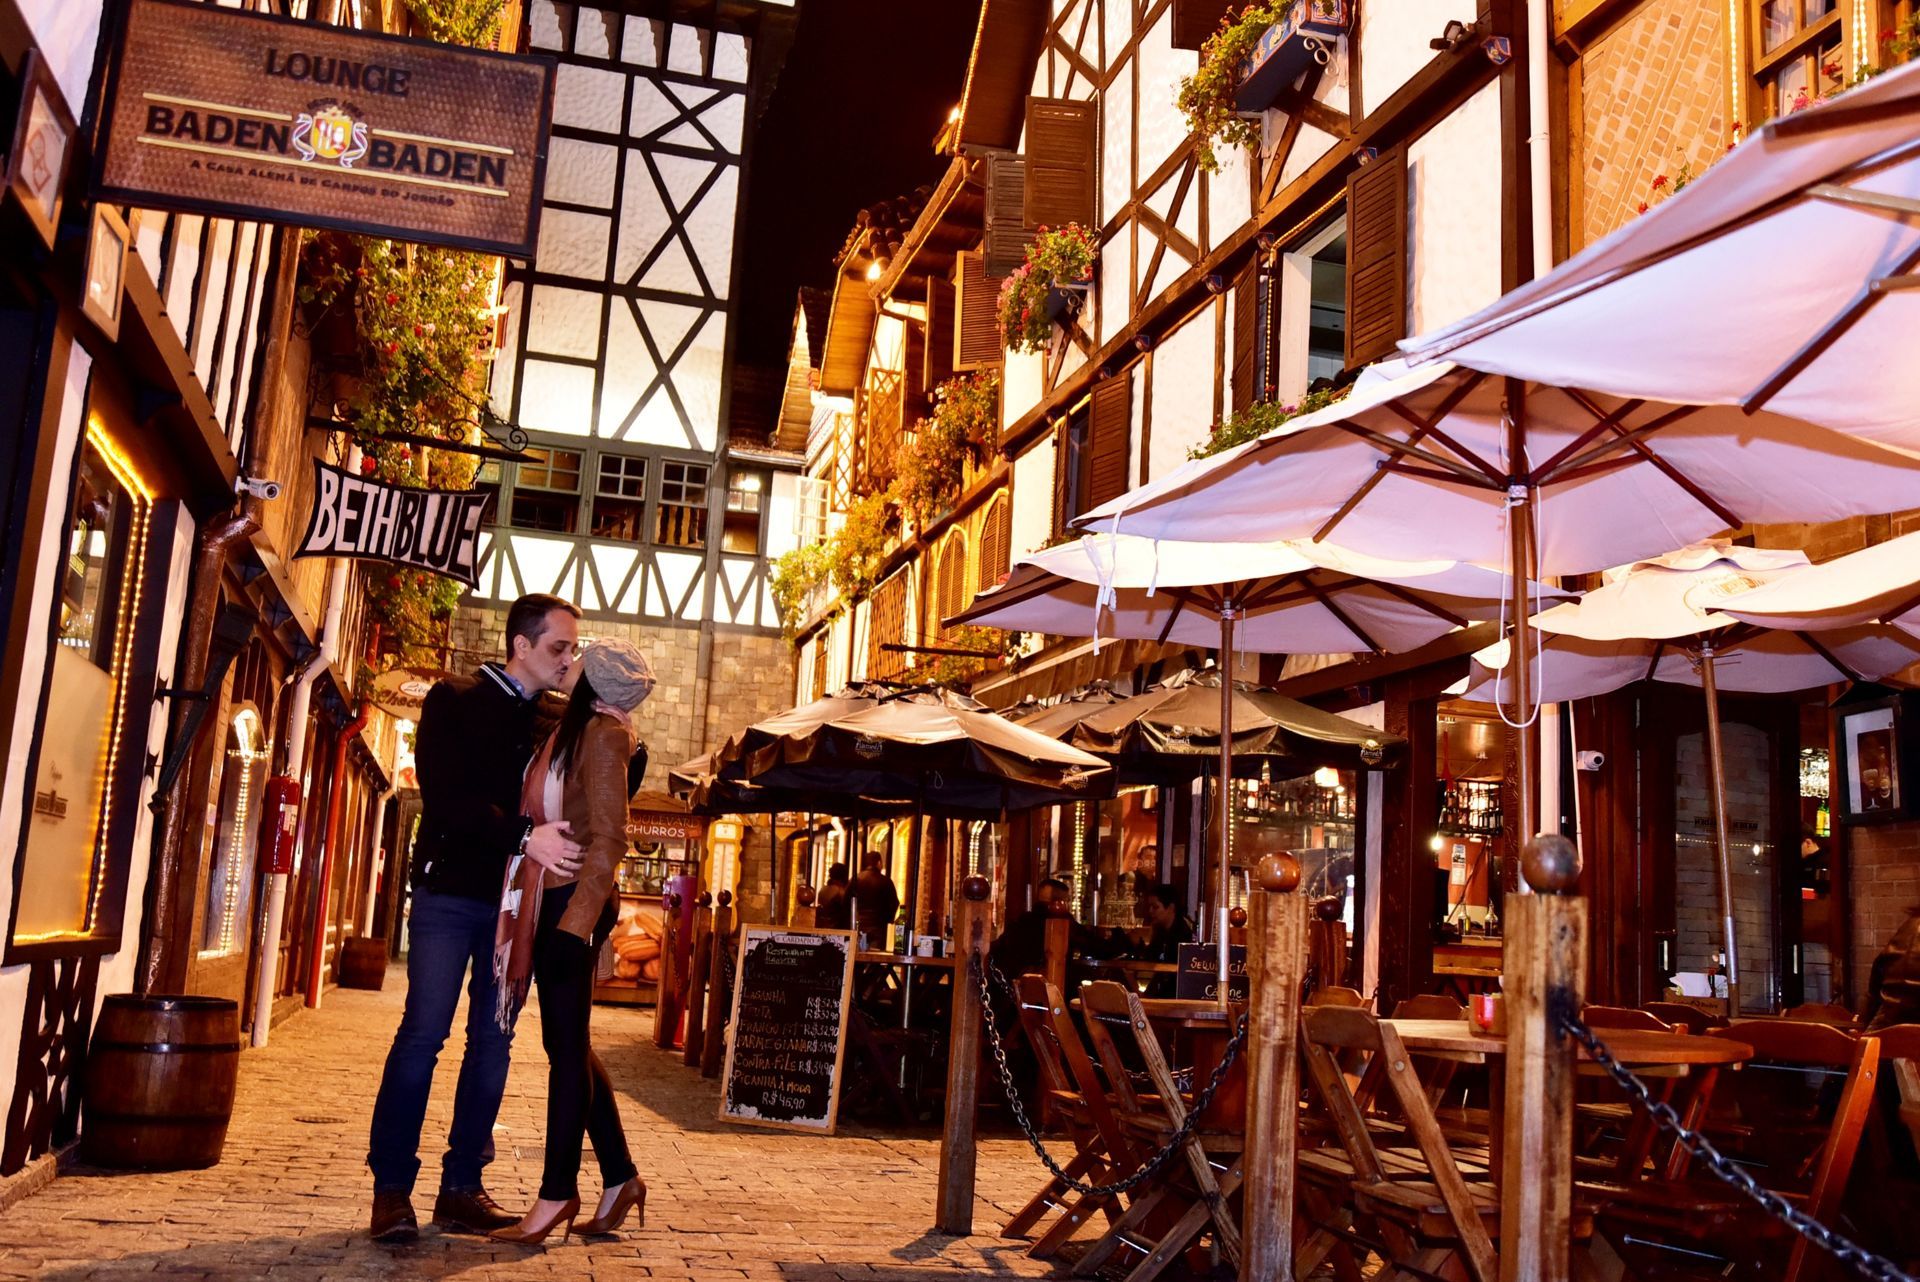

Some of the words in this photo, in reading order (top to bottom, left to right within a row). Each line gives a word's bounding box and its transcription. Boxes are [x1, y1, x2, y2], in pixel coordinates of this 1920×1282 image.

[265, 48, 412, 97] LOUNGE
[145, 105, 290, 154] BADEN
[367, 138, 507, 185] BADEN
[631, 813, 699, 828] OULEVARD
[625, 823, 686, 838] CHURROS
[1204, 984, 1242, 998] Cane
